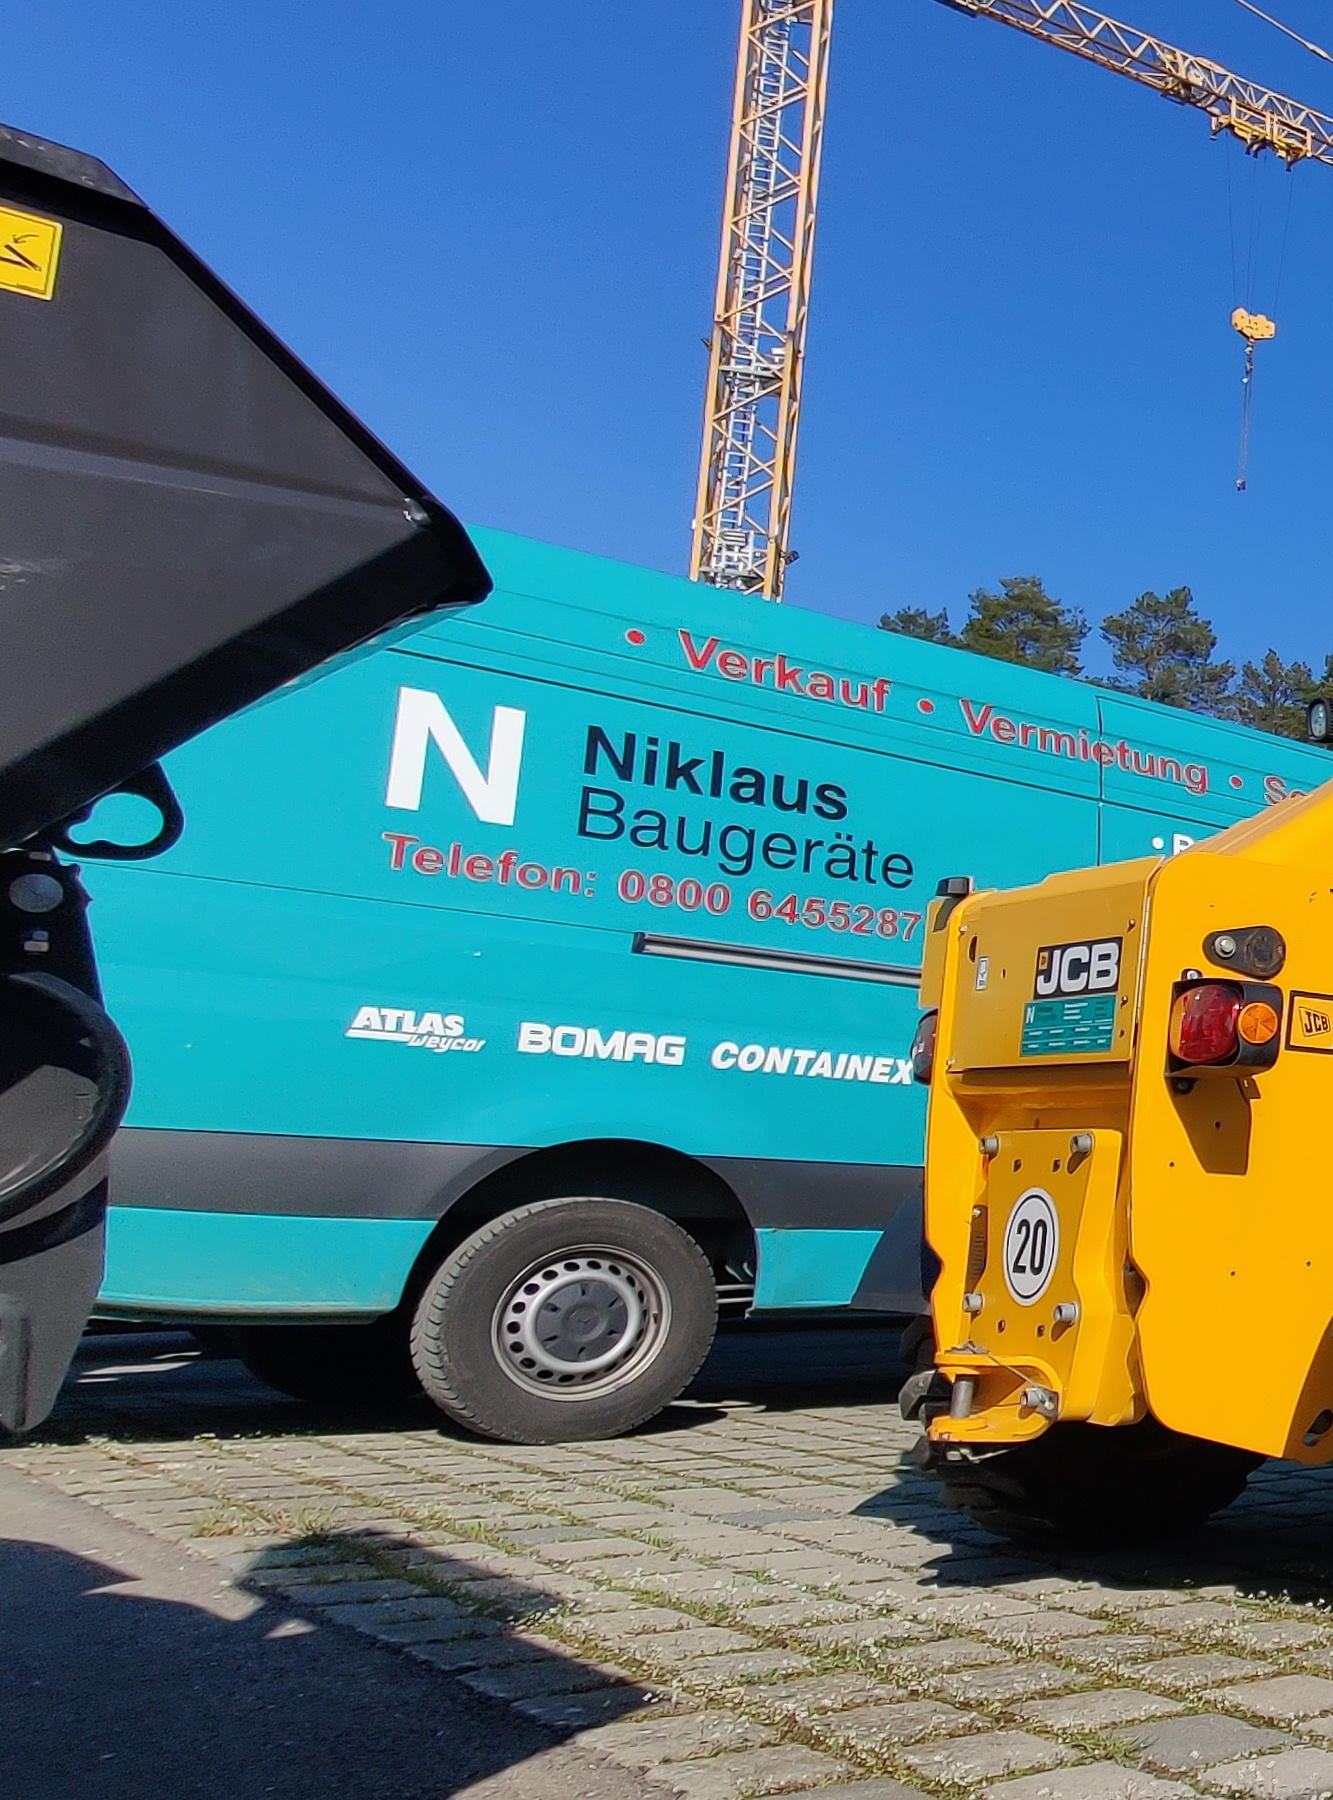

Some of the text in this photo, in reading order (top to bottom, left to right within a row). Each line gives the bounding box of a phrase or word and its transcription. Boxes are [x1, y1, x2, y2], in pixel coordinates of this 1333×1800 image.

[677, 628, 892, 714] Verkauf
[958, 697, 1209, 795] Vermietung
[385, 685, 527, 827] N
[583, 725, 850, 821] Niklaus
[576, 786, 915, 889] Baugeräte
[381, 832, 923, 942] Telefon: 0800 6455287
[1036, 942, 1120, 995] JCB
[350, 1006, 465, 1037] ATLAS
[516, 1021, 687, 1065] BOMAG
[1303, 1010, 1330, 1034] JCB
[711, 1041, 914, 1085] CONTAINEX
[1012, 1218, 1048, 1276] 20
